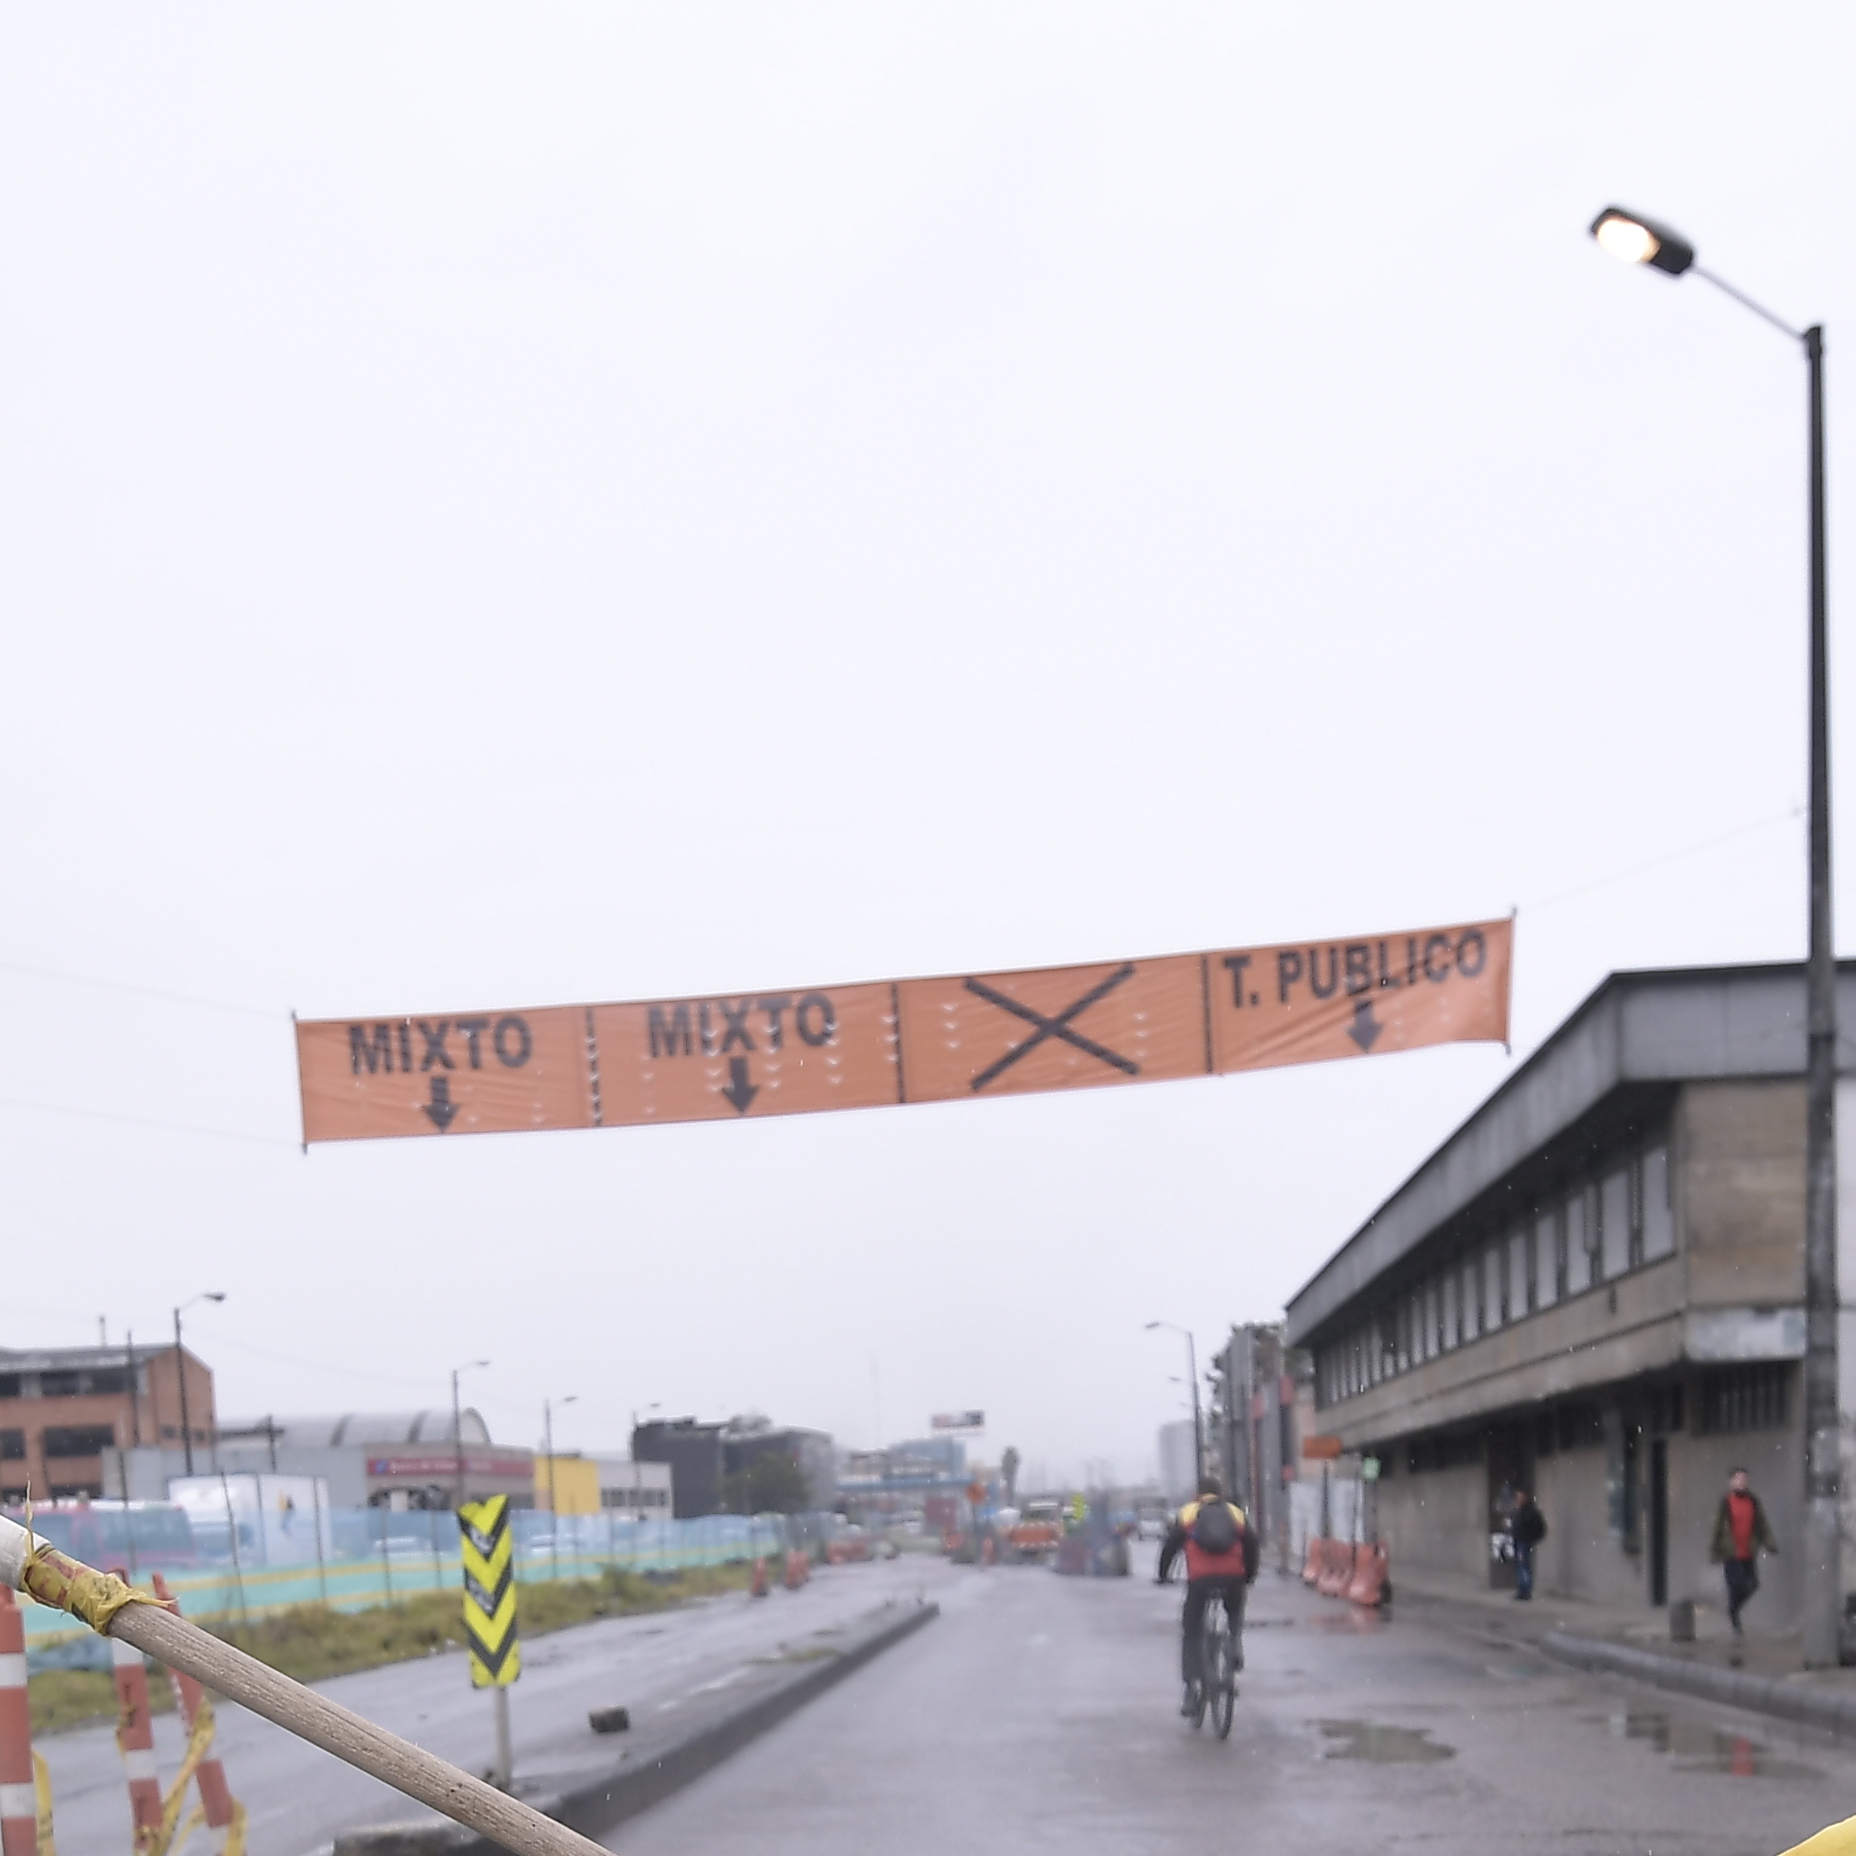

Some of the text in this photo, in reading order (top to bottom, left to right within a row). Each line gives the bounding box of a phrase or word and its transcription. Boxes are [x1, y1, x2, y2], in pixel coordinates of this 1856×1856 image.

[1222, 929, 1487, 1009] T. PUBLICO
[349, 1014, 533, 1076] MIXTO
[647, 991, 837, 1059] MIXTO
